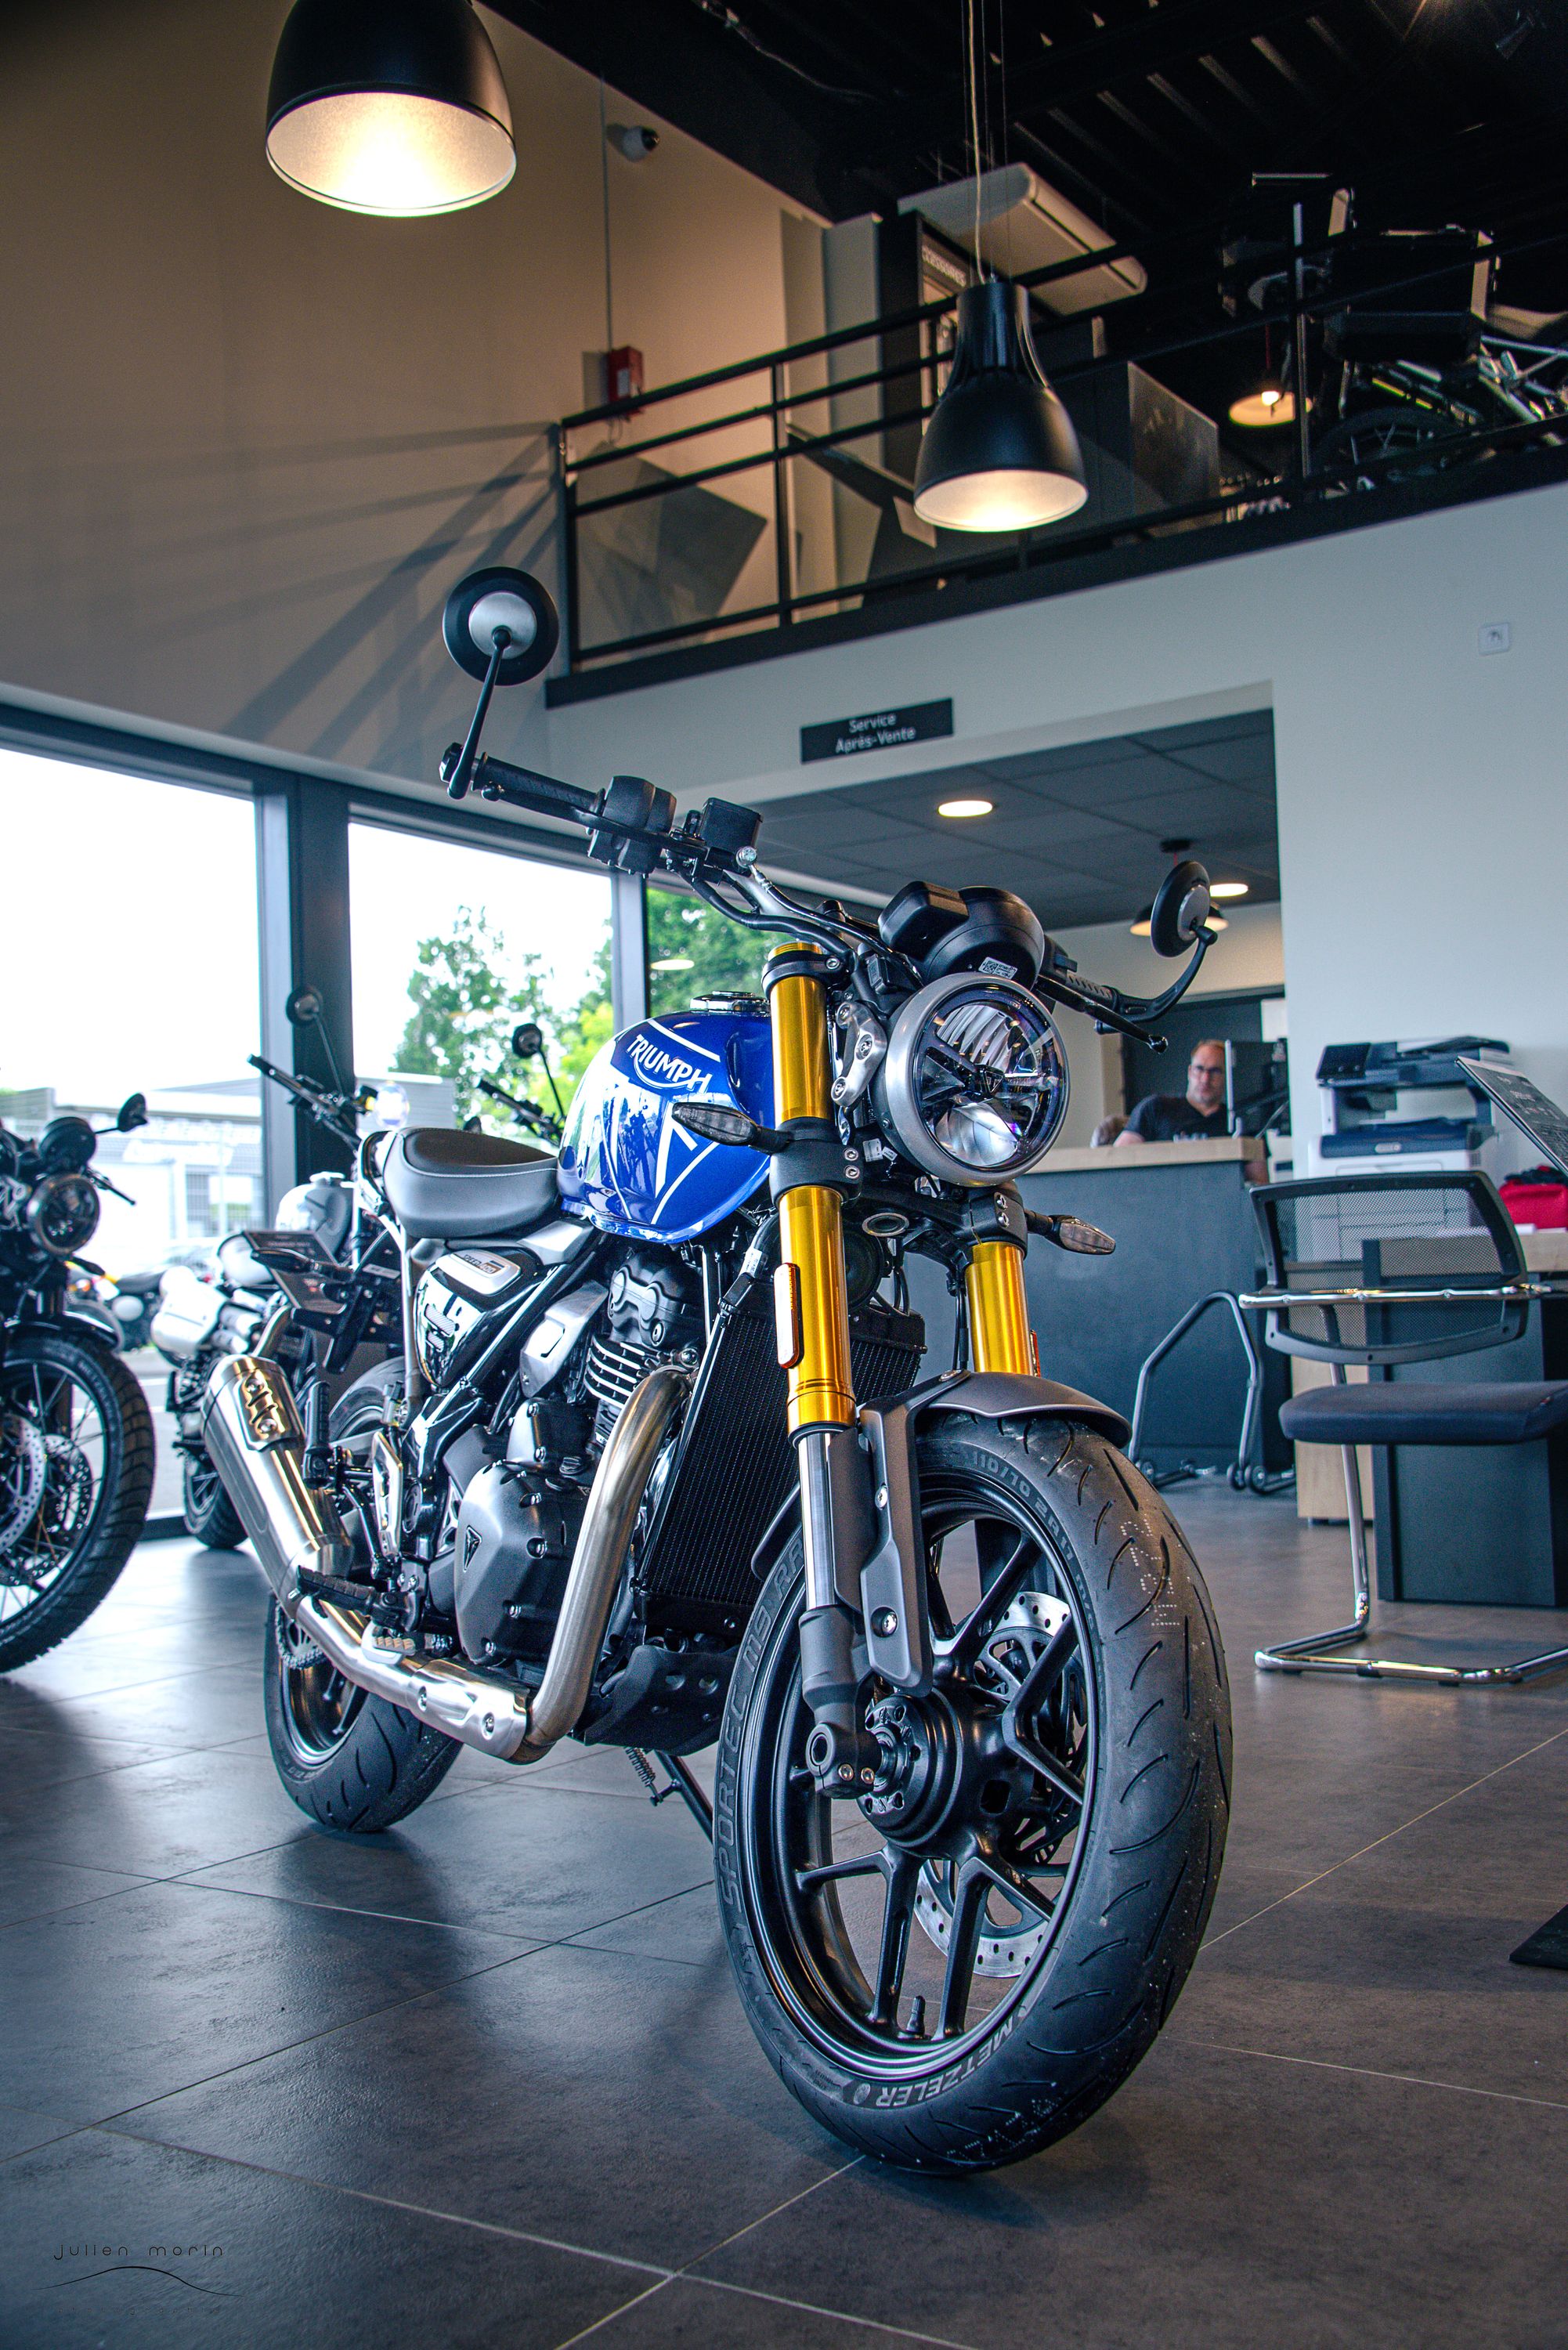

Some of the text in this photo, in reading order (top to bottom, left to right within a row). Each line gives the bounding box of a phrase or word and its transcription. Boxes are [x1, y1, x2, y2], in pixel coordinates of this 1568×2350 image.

[836, 727, 916, 754] Après-Vente
[849, 713, 897, 733] Service
[626, 1034, 714, 1094] TRIUMPH
[716, 1693, 749, 1916] SPORTEC
[742, 1608, 772, 1673] M9
[774, 1537, 804, 1601] RR
[876, 2016, 1013, 2107] METZELER
